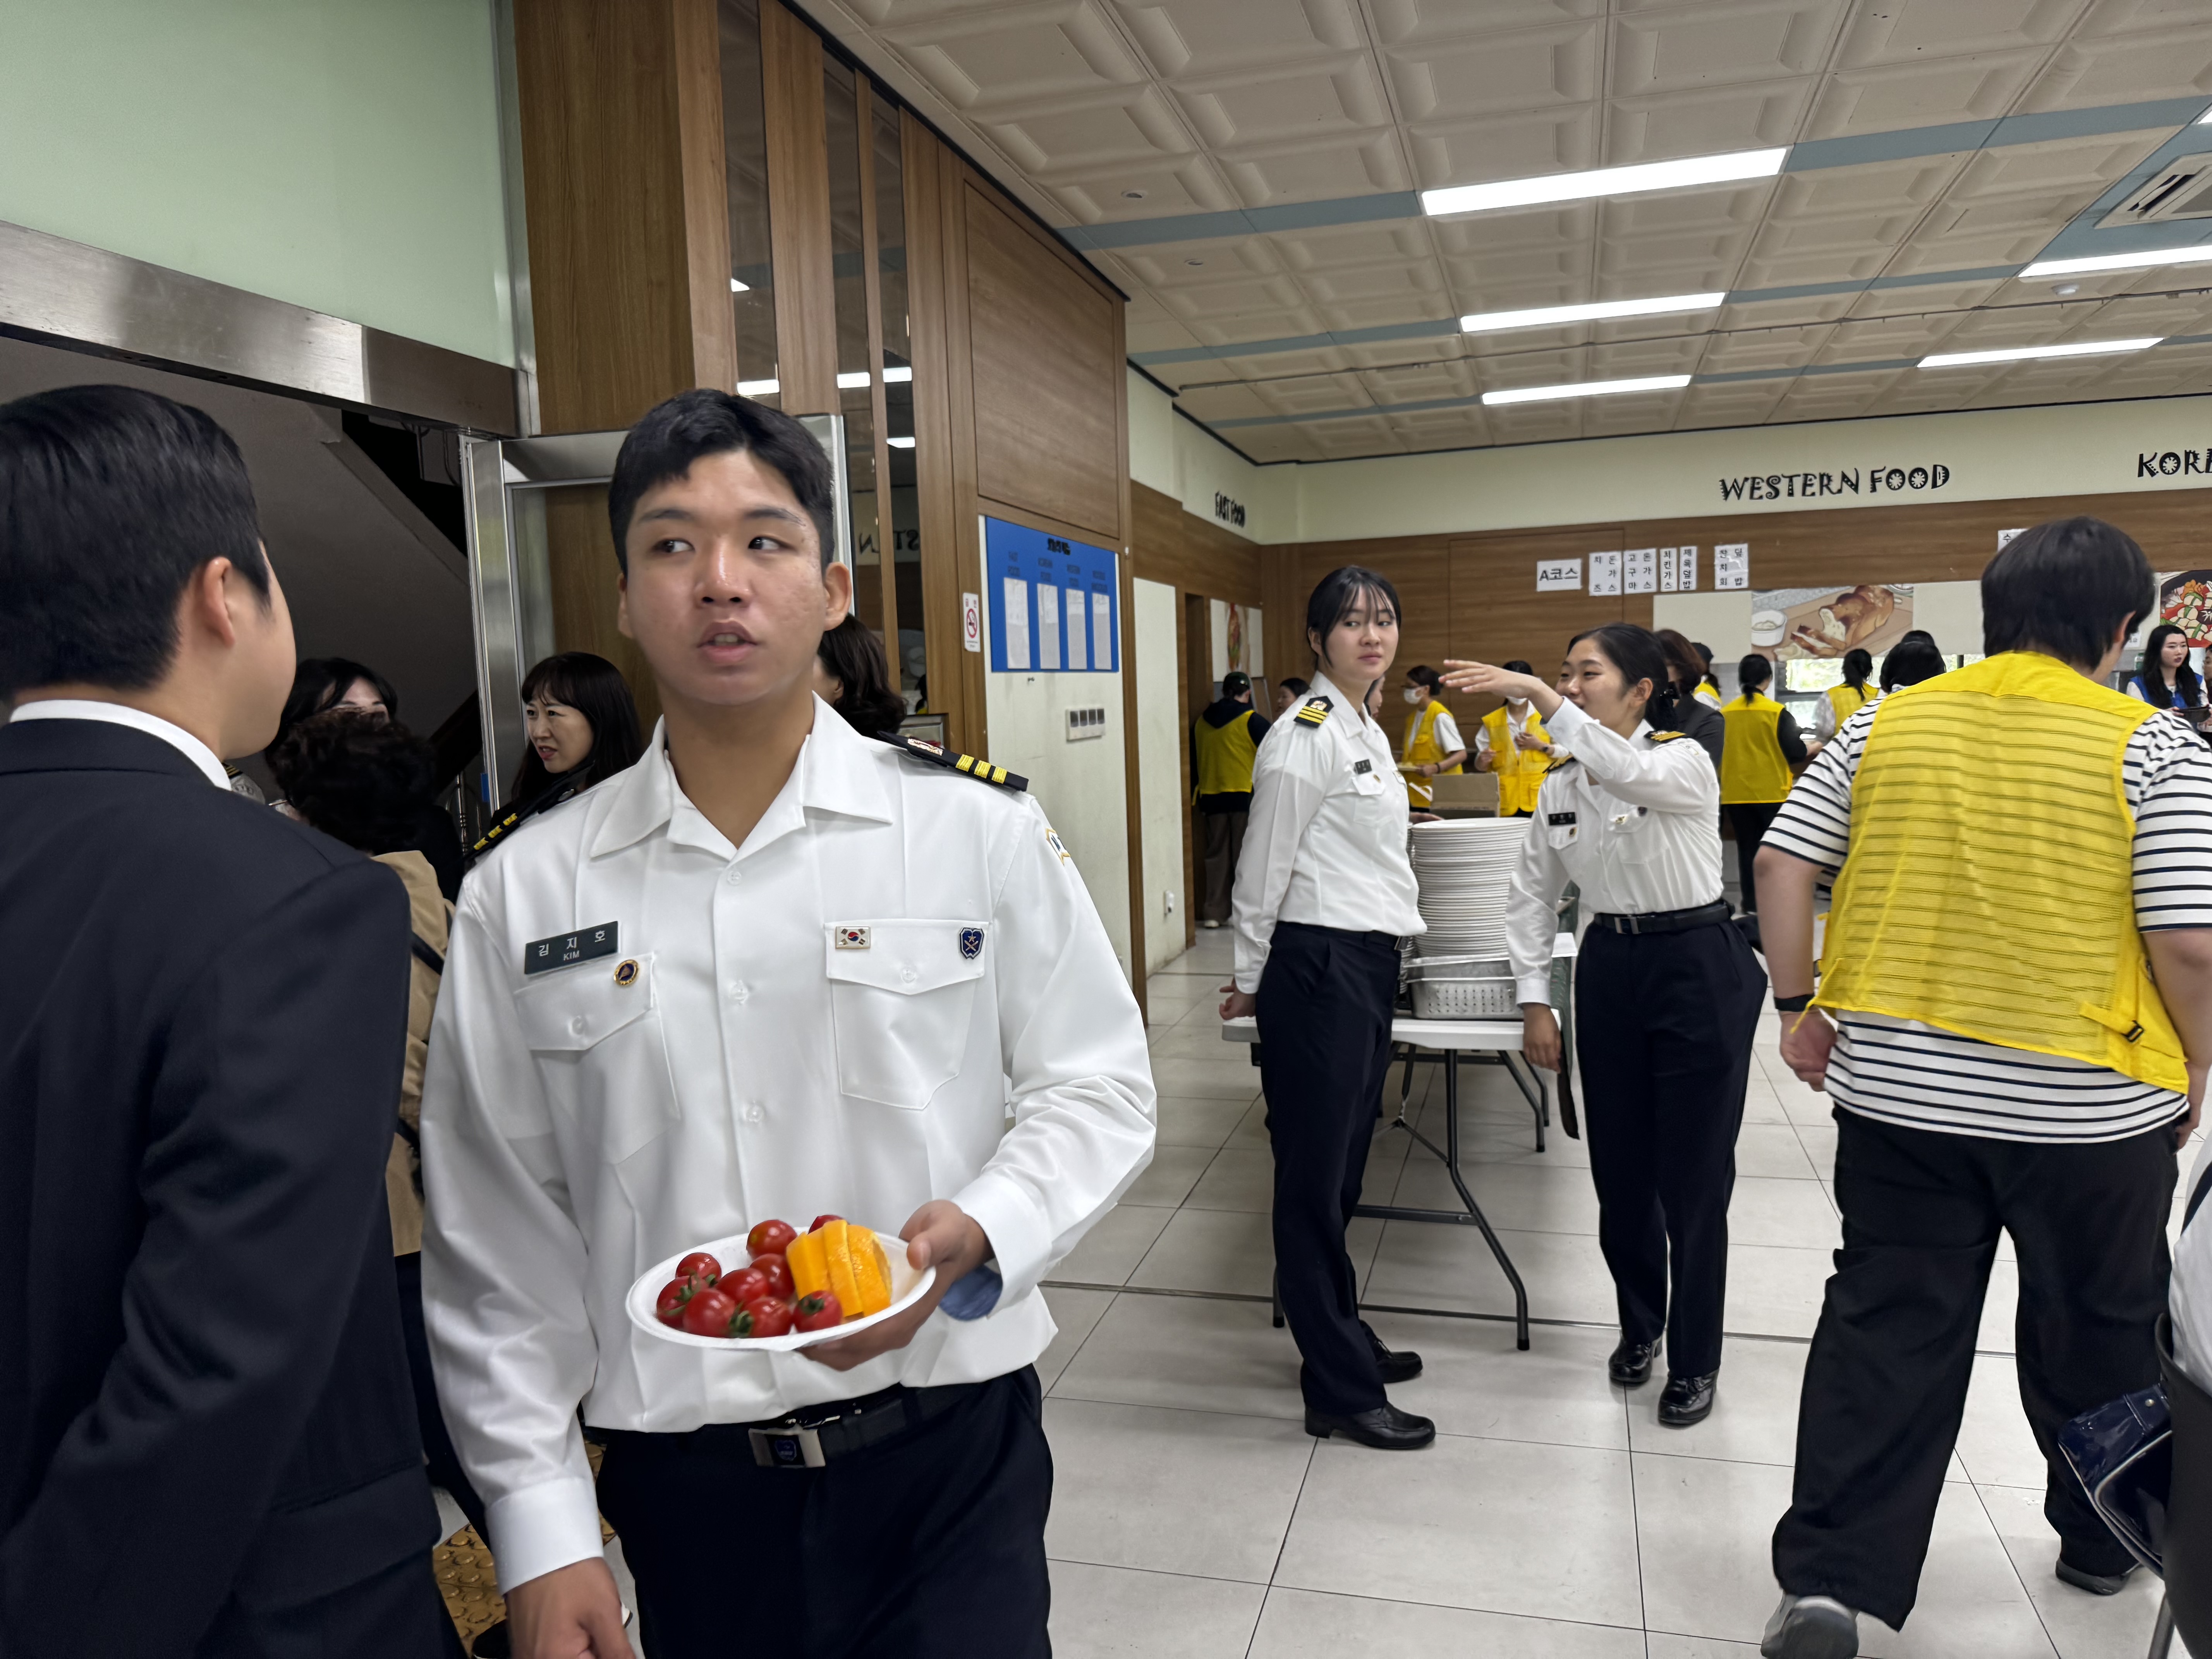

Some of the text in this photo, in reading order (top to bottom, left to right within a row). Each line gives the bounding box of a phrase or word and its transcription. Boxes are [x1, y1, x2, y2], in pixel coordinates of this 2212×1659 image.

[1719, 464, 1950, 501] WESTERN FOOD
[1539, 567, 1578, 581] A코스
[1628, 554, 1637, 590] 고구마
[563, 950, 580, 961] KIM
